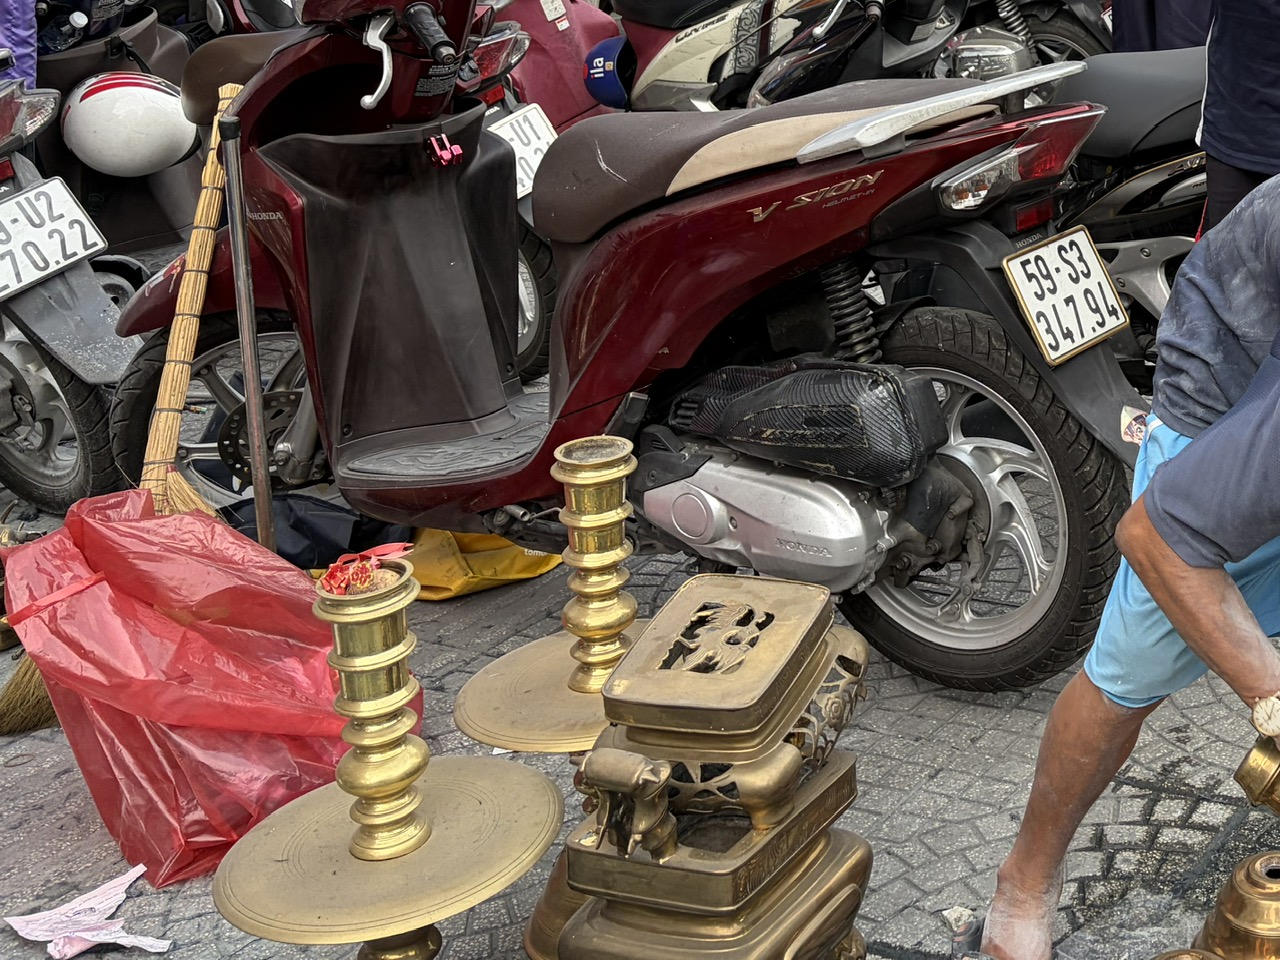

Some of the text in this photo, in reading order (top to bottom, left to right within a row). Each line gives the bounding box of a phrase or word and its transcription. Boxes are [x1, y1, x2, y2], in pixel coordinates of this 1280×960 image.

[590, 57, 605, 79] ila
[822, 188, 875, 209] HELMET-IN
[251, 211, 284, 221] HONDA
[1015, 233, 1043, 249] HONDA
[0, 219, 99, 290] 70.22
[1020, 239, 1092, 302] 59-S3
[1035, 281, 1120, 352] 347.94
[775, 538, 832, 557] HONDA
